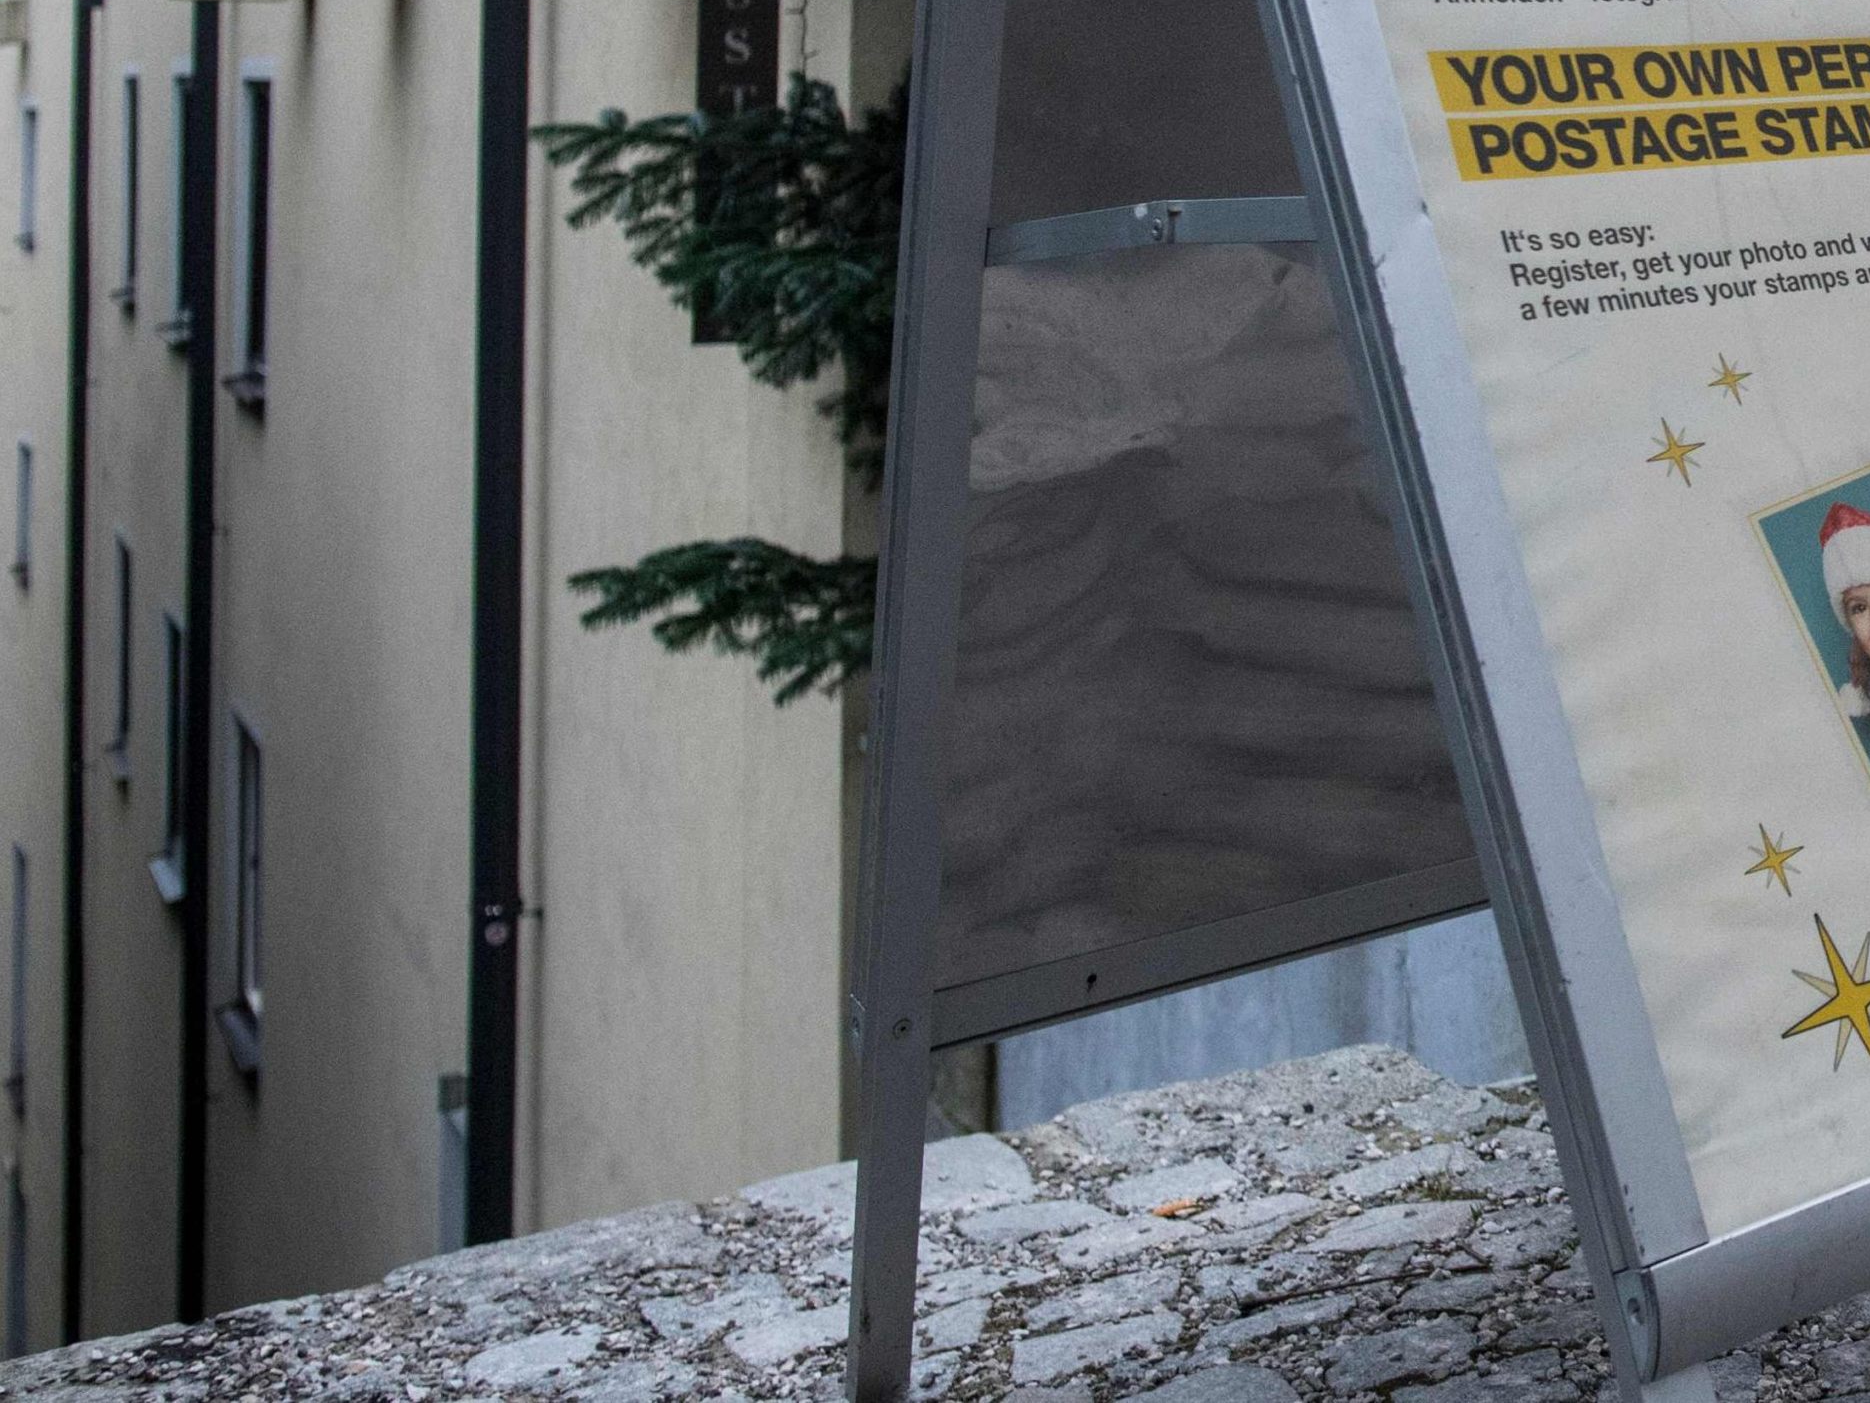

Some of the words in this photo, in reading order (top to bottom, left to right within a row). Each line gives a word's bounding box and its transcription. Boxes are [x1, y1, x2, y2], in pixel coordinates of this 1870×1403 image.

[1446, 50, 1622, 106] YOUR
[1634, 47, 1769, 99] OWN
[1468, 111, 1748, 175] POSTAGE
[1510, 259, 1626, 289] Register,
[1633, 252, 1674, 280] get
[1678, 250, 1732, 276] your
[1739, 240, 1807, 269] photo
[1814, 233, 1856, 257] and
[1549, 231, 1580, 249] so
[1588, 225, 1654, 247] easy:
[1520, 303, 1537, 320] a
[1542, 295, 1589, 317] few
[1598, 285, 1699, 312] minutes
[1703, 280, 1756, 306] your
[1765, 271, 1849, 294] stamps
